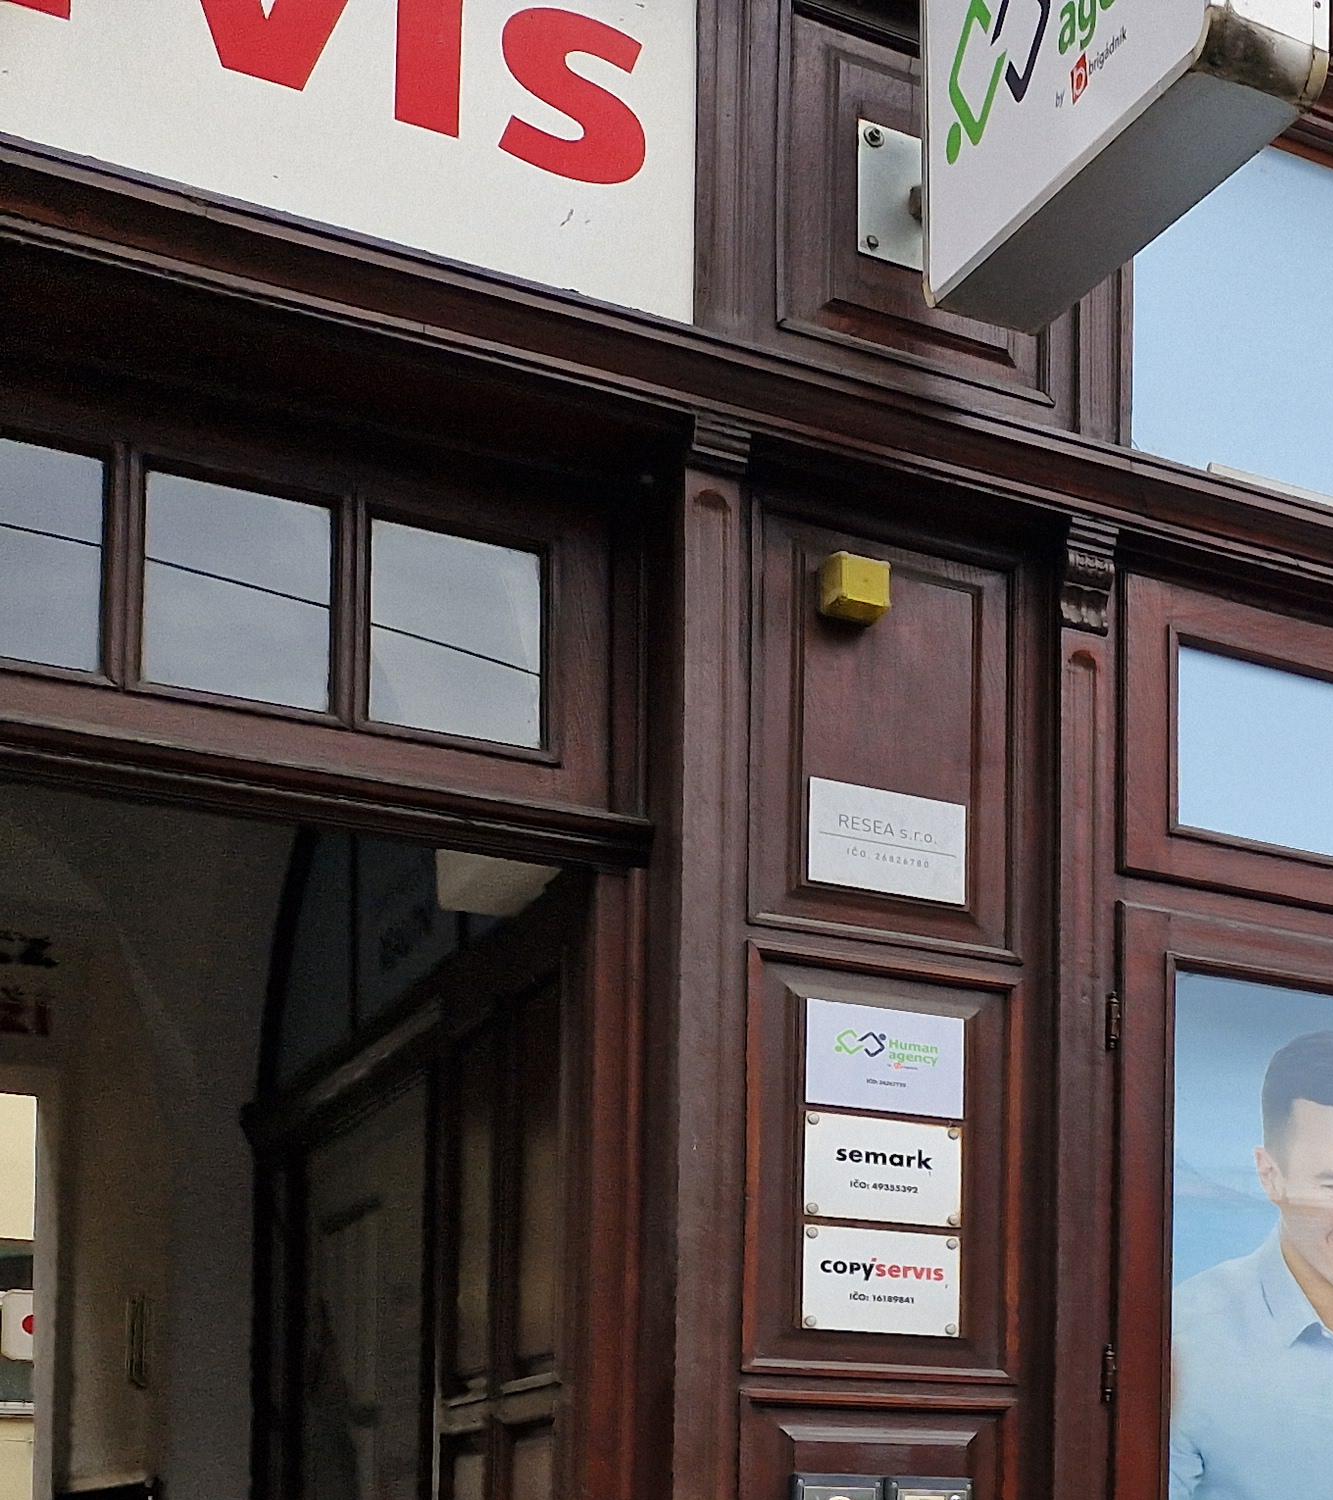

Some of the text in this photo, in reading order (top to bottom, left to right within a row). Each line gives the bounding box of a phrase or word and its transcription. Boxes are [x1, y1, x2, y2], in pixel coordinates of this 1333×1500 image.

[1055, 89, 1065, 108] by
[838, 814, 937, 844] RESEA s.r.o.
[888, 1039, 938, 1055] Human
[888, 1050, 938, 1067] agency
[835, 1148, 933, 1170] semark
[849, 1179, 870, 1191] IČO:
[849, 1291, 869, 1302] IČO:
